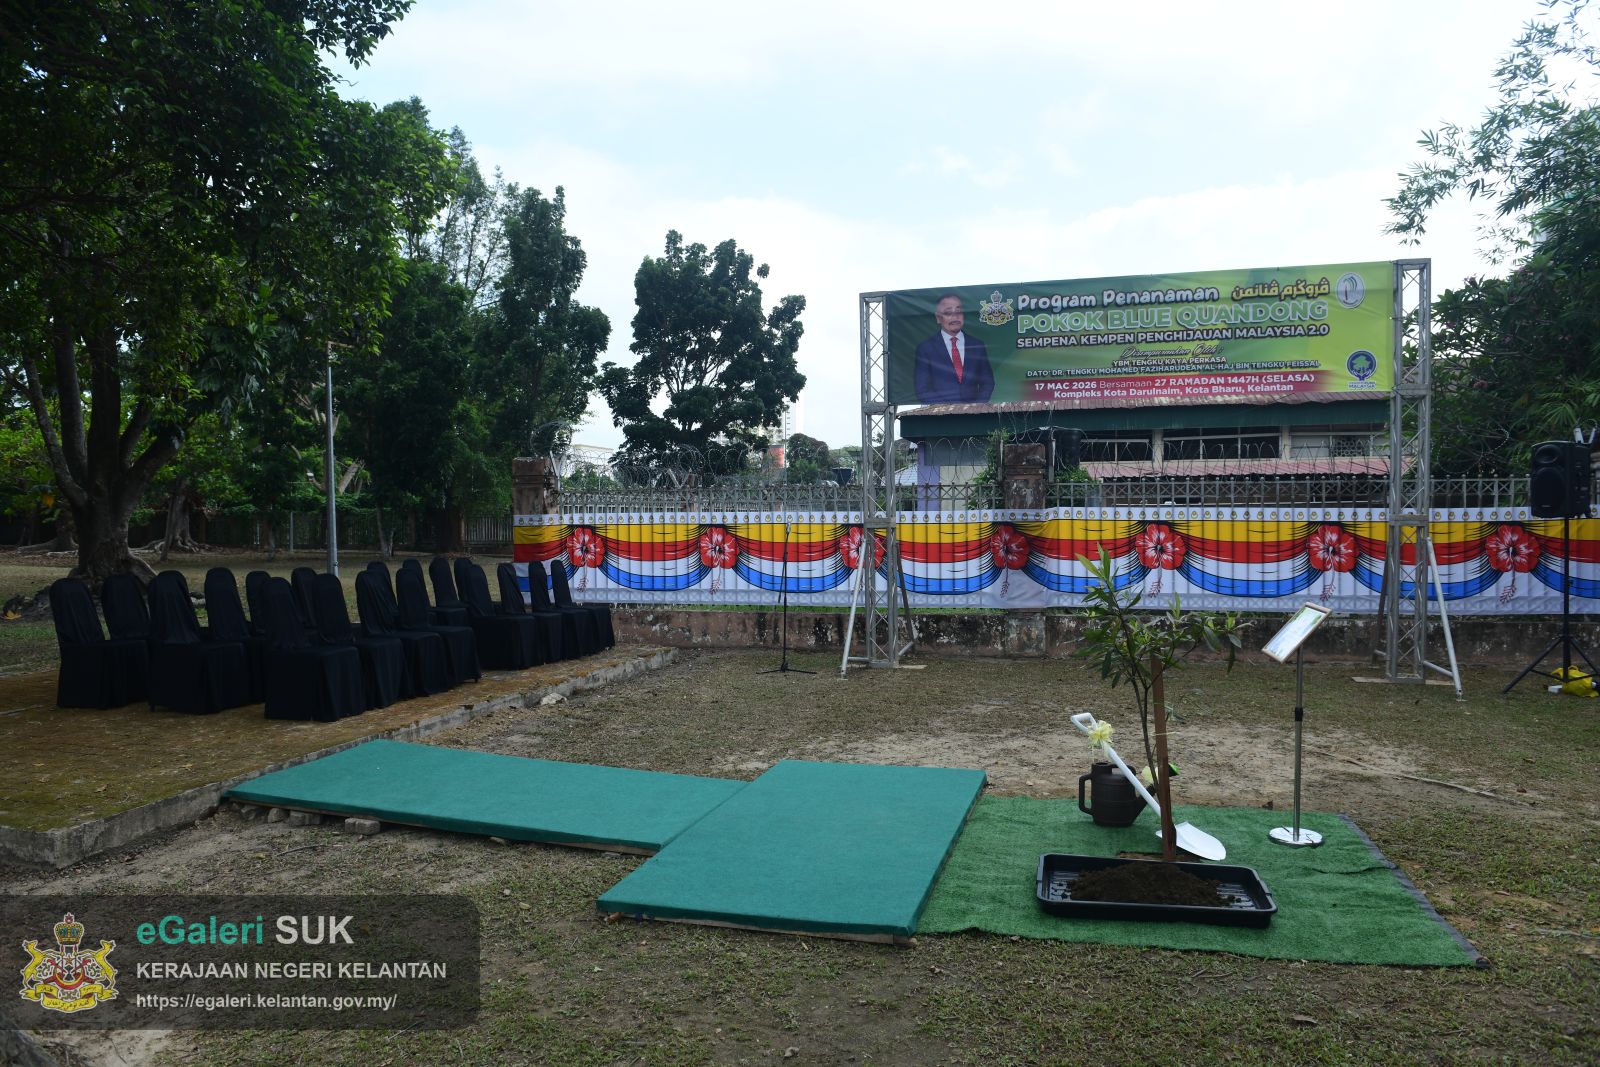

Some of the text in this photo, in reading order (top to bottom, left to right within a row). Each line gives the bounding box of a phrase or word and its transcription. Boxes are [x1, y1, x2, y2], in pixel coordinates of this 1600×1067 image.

[1017, 288, 1219, 313] Program Penanaman
[1017, 300, 1328, 334] POKOK BLUE QUANDONG
[1017, 324, 1329, 348] SEMPENA KEMPEN PENGHIJAUAN MALAYSIA 2.0
[1251, 361, 1284, 369] TENGKU
[1287, 360, 1320, 368] FEISSAL
[1034, 374, 1315, 391] 17 MAC 2026 Bersamaan 27 RAMADAN 1447H (SELASA)
[1054, 390, 1102, 399] Kompleks
[1104, 388, 1127, 397] Kota
[1185, 386, 1209, 394] Kota
[1211, 384, 1245, 394] Bharu,
[1247, 383, 1294, 392] Kelantan
